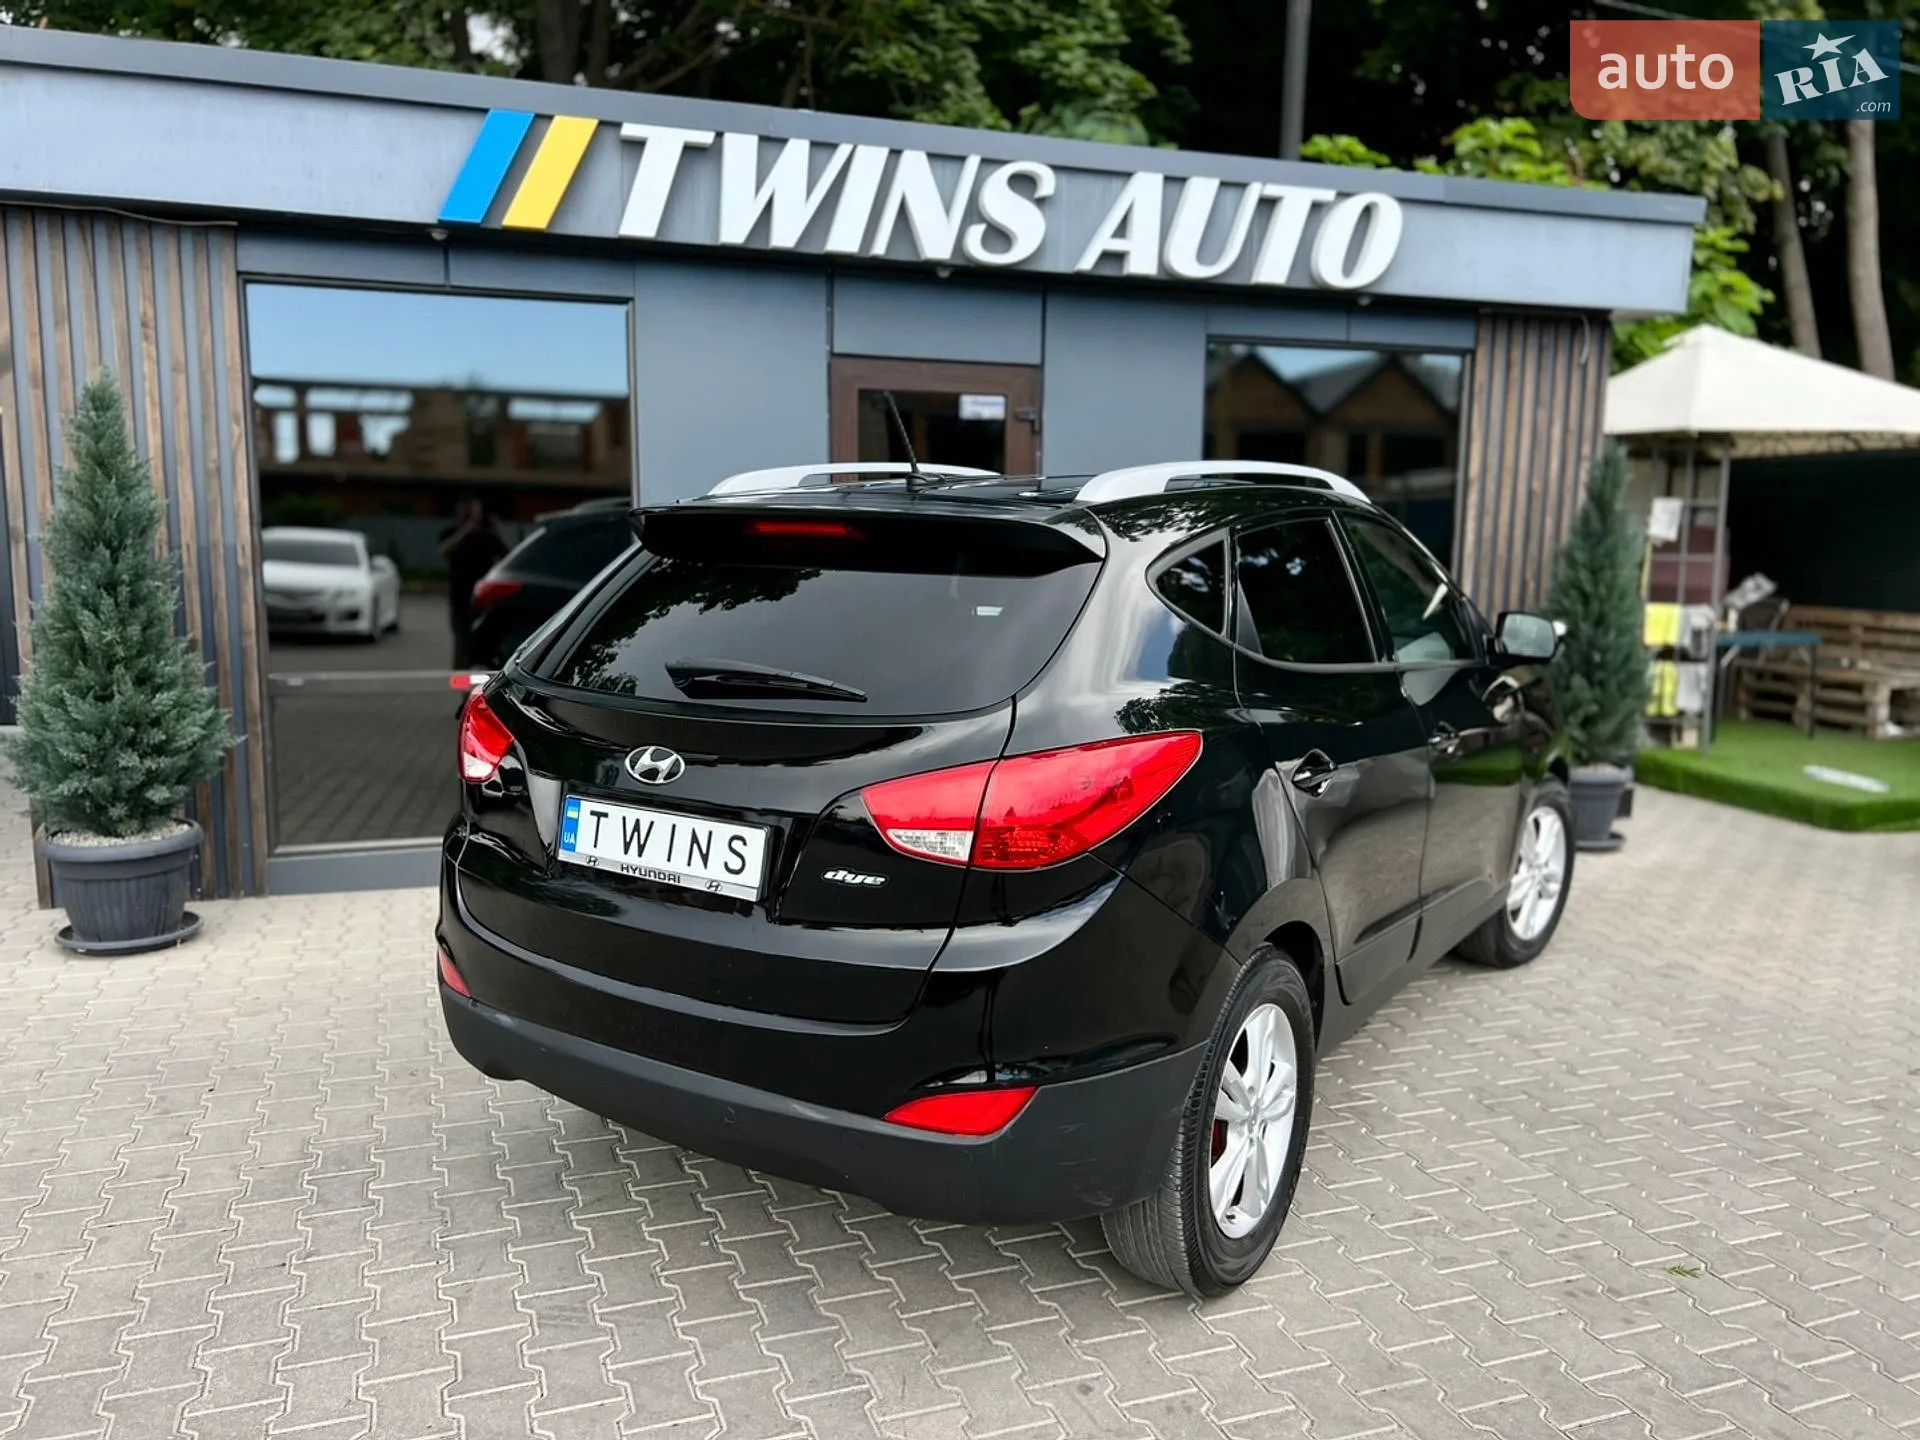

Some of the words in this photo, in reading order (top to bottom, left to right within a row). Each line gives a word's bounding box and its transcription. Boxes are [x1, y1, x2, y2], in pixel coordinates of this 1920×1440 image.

[616, 122, 1056, 267] TWINS
[1073, 170, 1405, 291] AUTO
[564, 831, 576, 844] UA
[588, 809, 748, 876] TWINS
[620, 863, 682, 884] HYUNDAI
